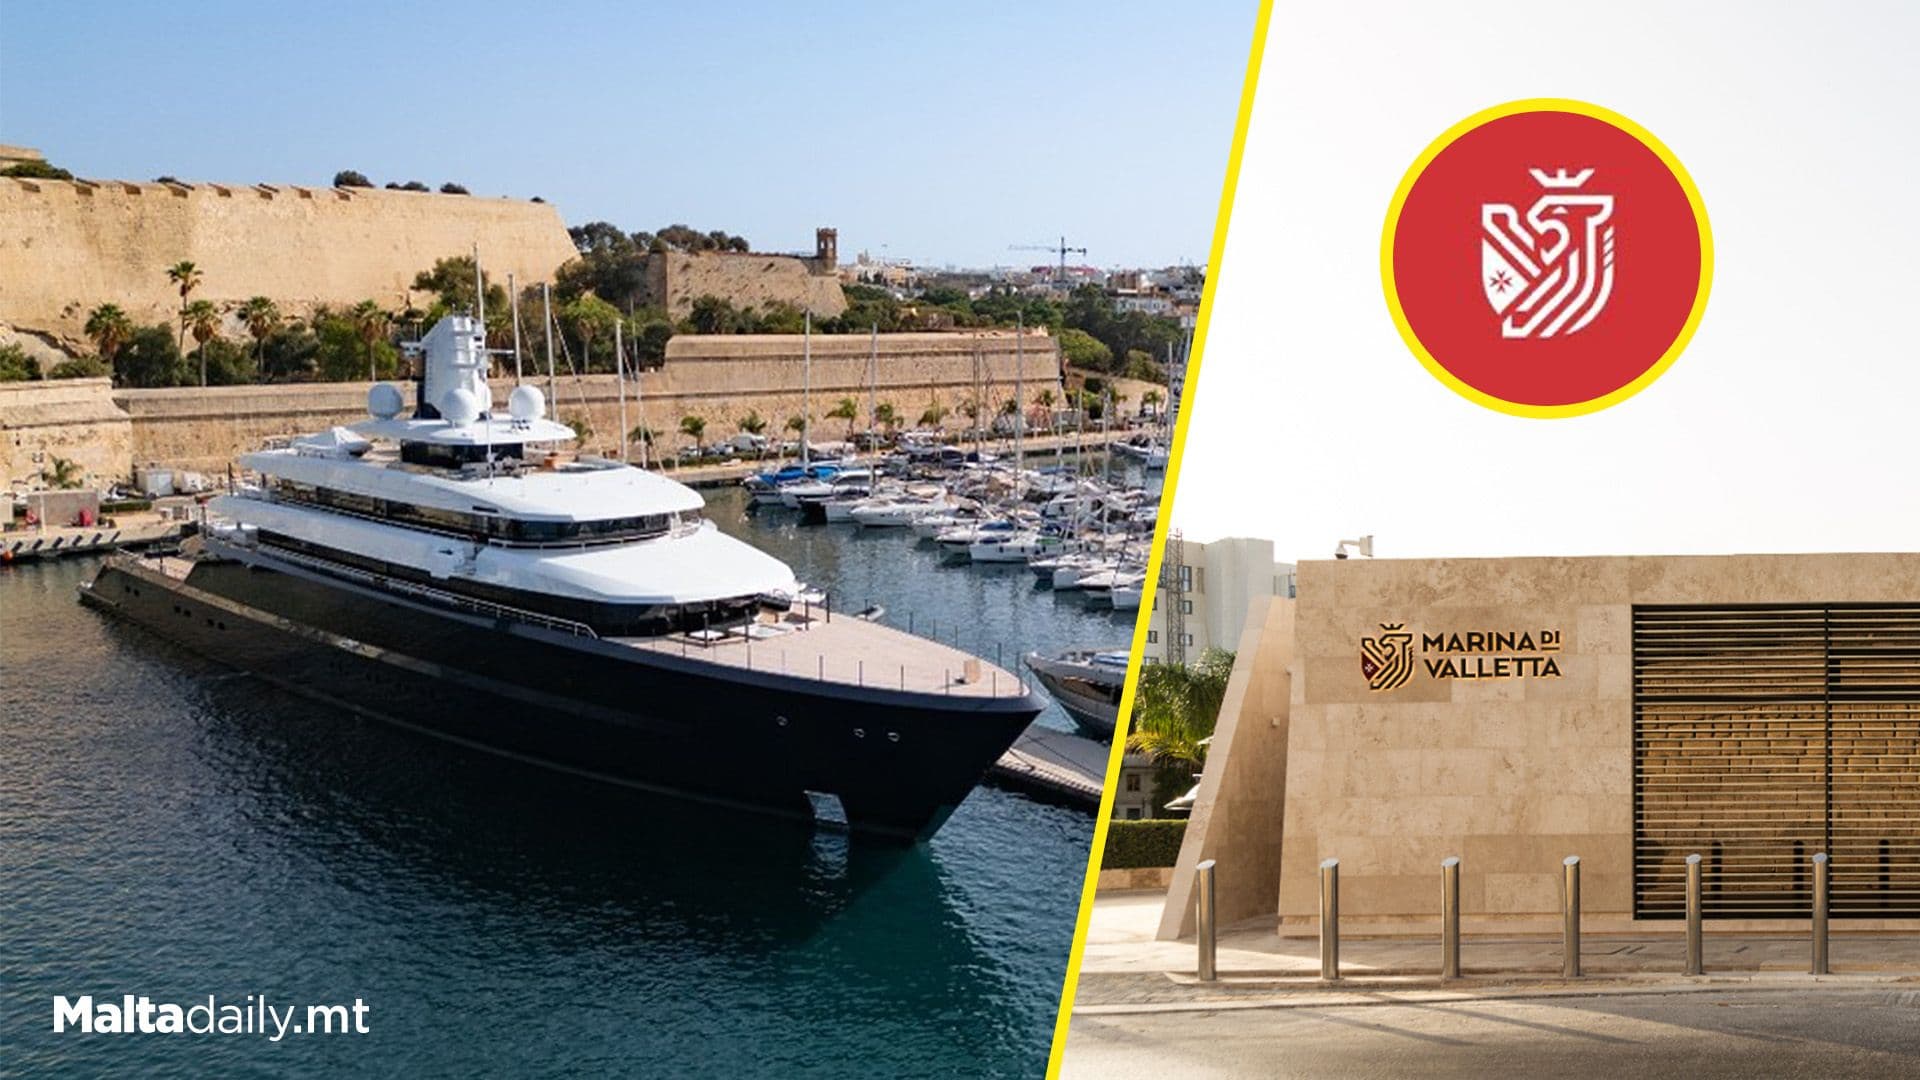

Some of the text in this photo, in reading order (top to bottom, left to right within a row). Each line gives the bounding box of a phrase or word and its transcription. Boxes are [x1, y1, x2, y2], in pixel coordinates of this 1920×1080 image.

[1422, 630, 1560, 652] MARINA DI
[1424, 657, 1562, 678] VALLETTA
